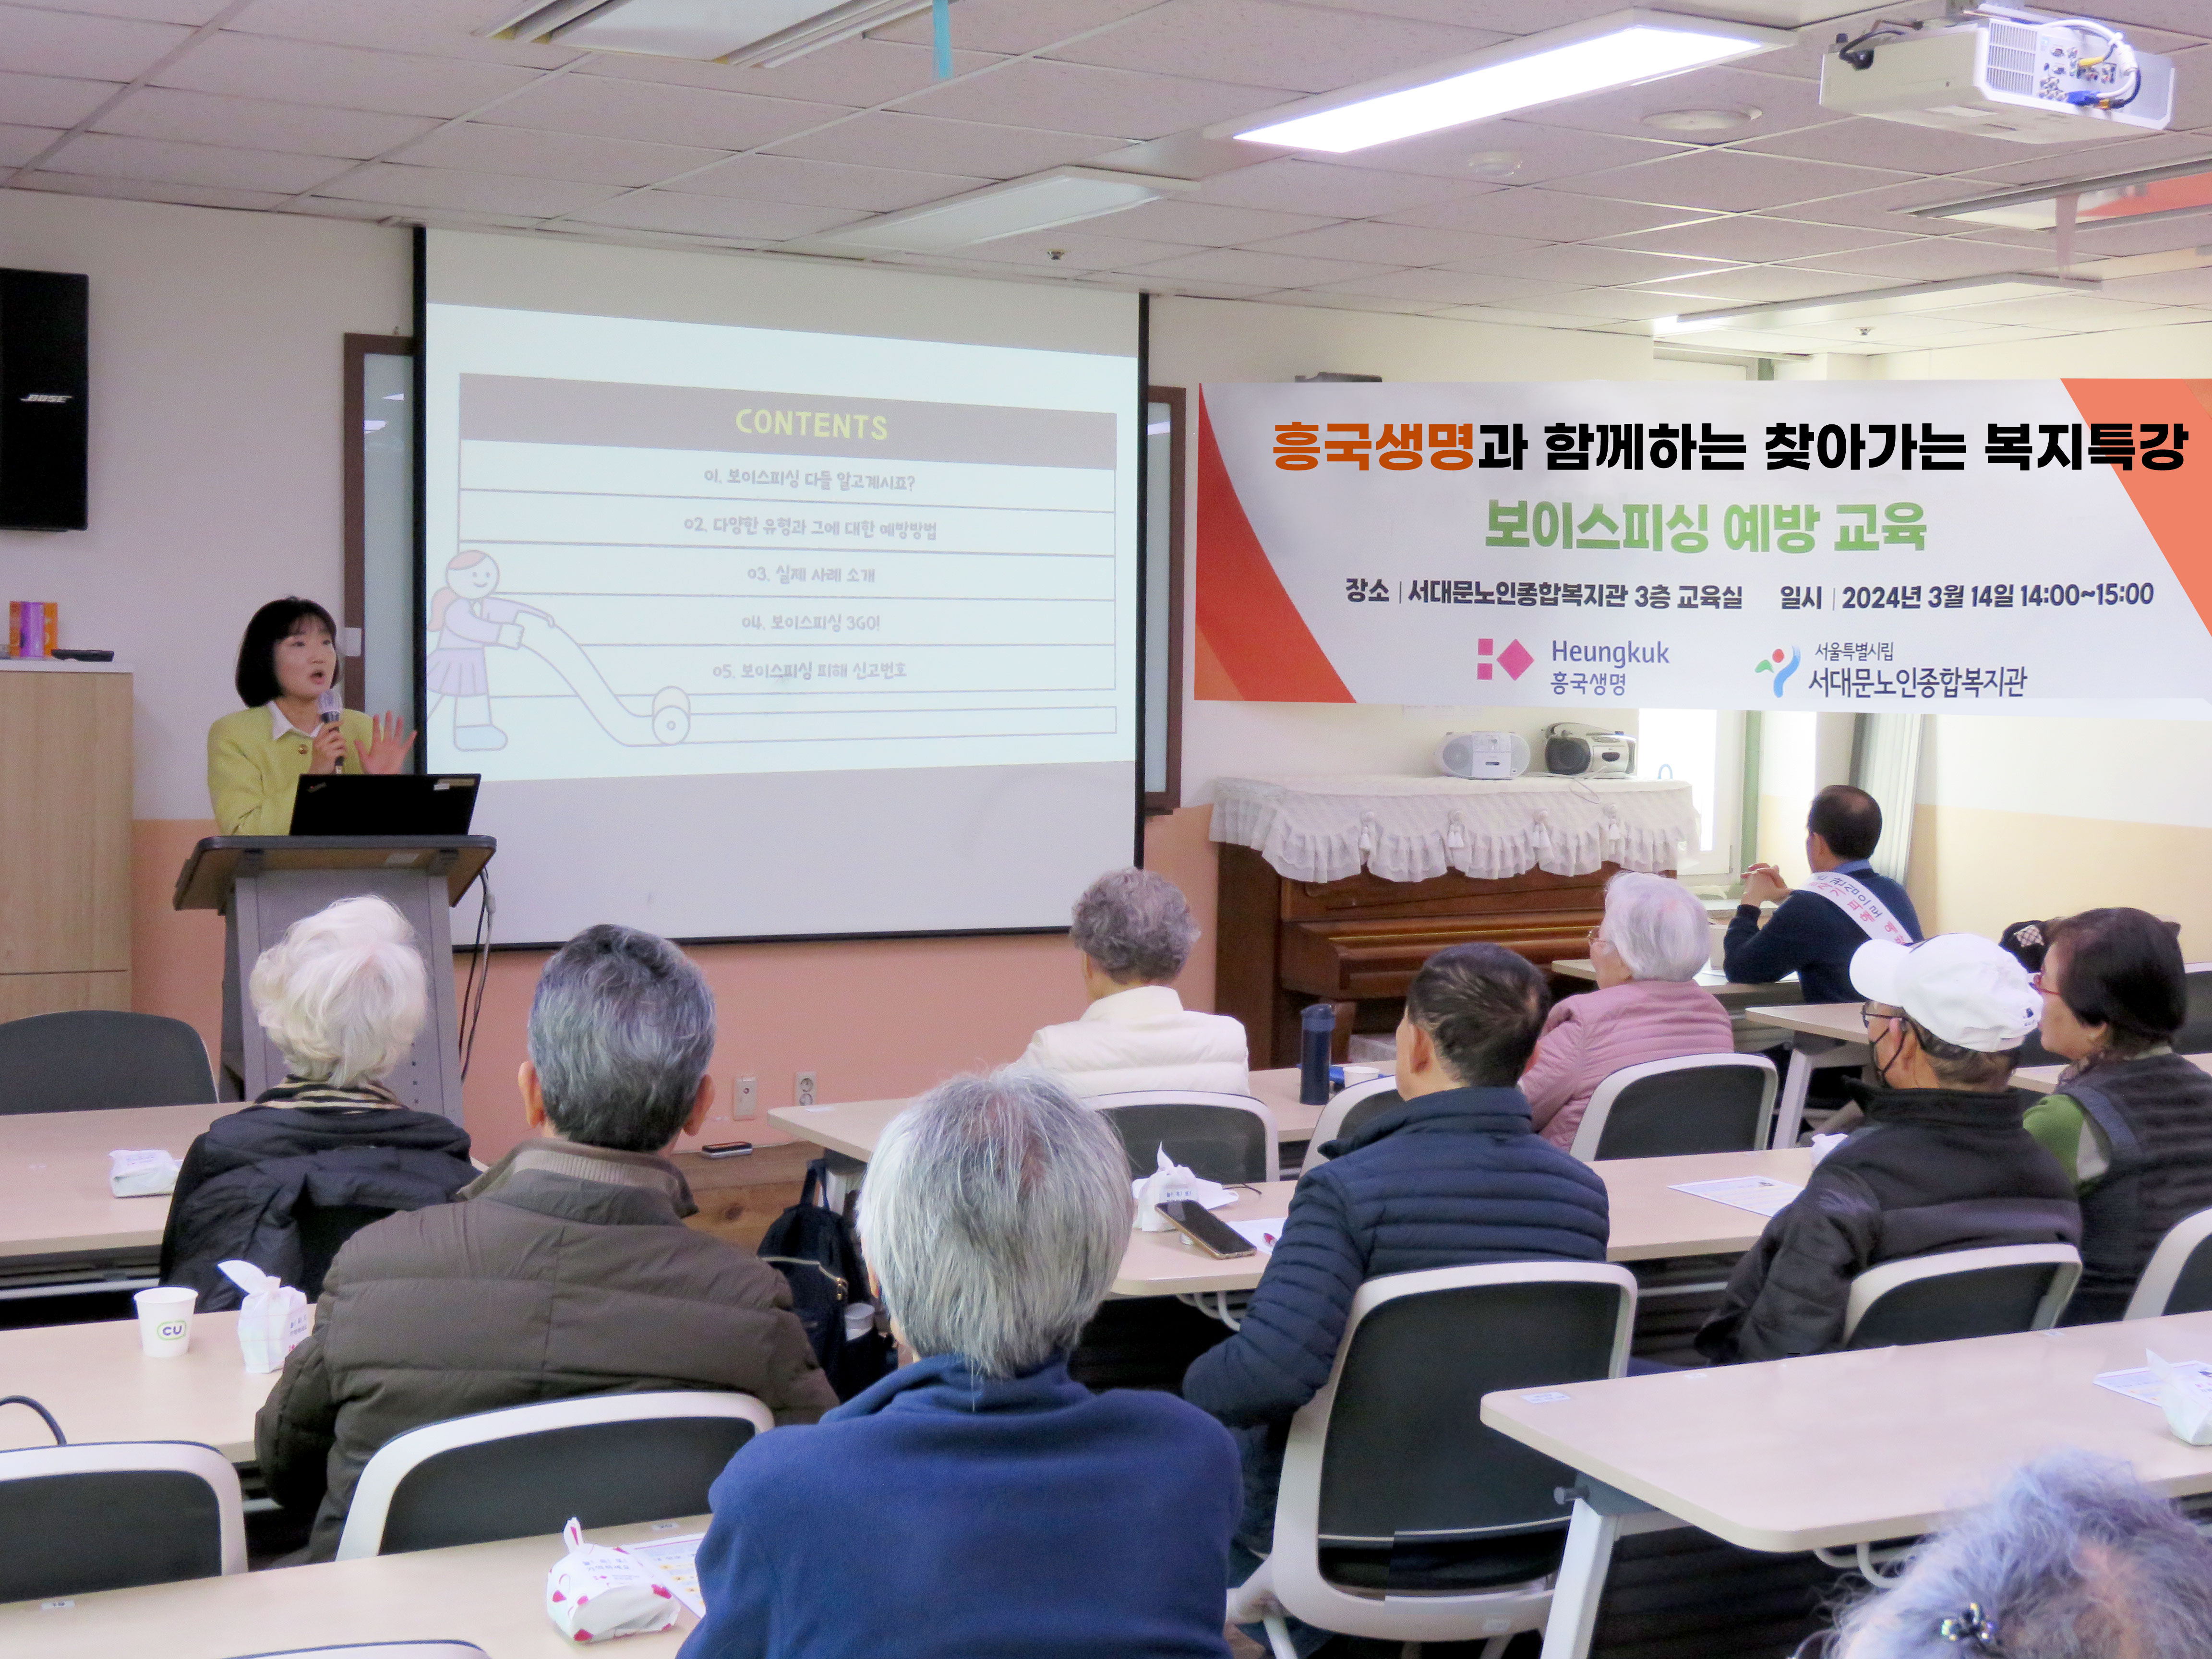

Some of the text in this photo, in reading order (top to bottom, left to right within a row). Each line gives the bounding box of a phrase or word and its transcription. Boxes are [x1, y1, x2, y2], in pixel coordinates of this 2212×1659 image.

[736, 409, 887, 440] CONTENTS
[1273, 421, 2189, 471] 흥국생명과 함께하는 찾아가는 복지특강
[727, 469, 799, 488] 보이스피싱
[805, 470, 832, 490] 다들
[714, 516, 758, 535] 다양한
[763, 517, 806, 536] 유형과
[812, 521, 840, 535] 그에
[845, 520, 875, 538] 대한
[879, 521, 936, 540] 예방방법
[1485, 499, 1927, 553] 보이스피싱 예방 교육
[776, 565, 806, 584] 실제
[812, 568, 841, 582] 사례
[847, 568, 875, 582] 소개
[1346, 578, 2154, 609] 장소 서대문노인종합복지관 3층 교육실 일시 2024년 3월 14일 14:00~15:00
[771, 614, 841, 632] 보이스피싱
[1552, 640, 1669, 669] Heungkuk
[1815, 642, 1893, 661] 서울특별시립
[742, 662, 812, 680] 보이스피싱
[817, 664, 847, 677] 피해
[853, 662, 906, 680] 신고번호
[1809, 666, 2028, 698] 서대문노인종합복지관
[1551, 672, 1625, 696] 흥국생명
[163, 1325, 182, 1335] CU
